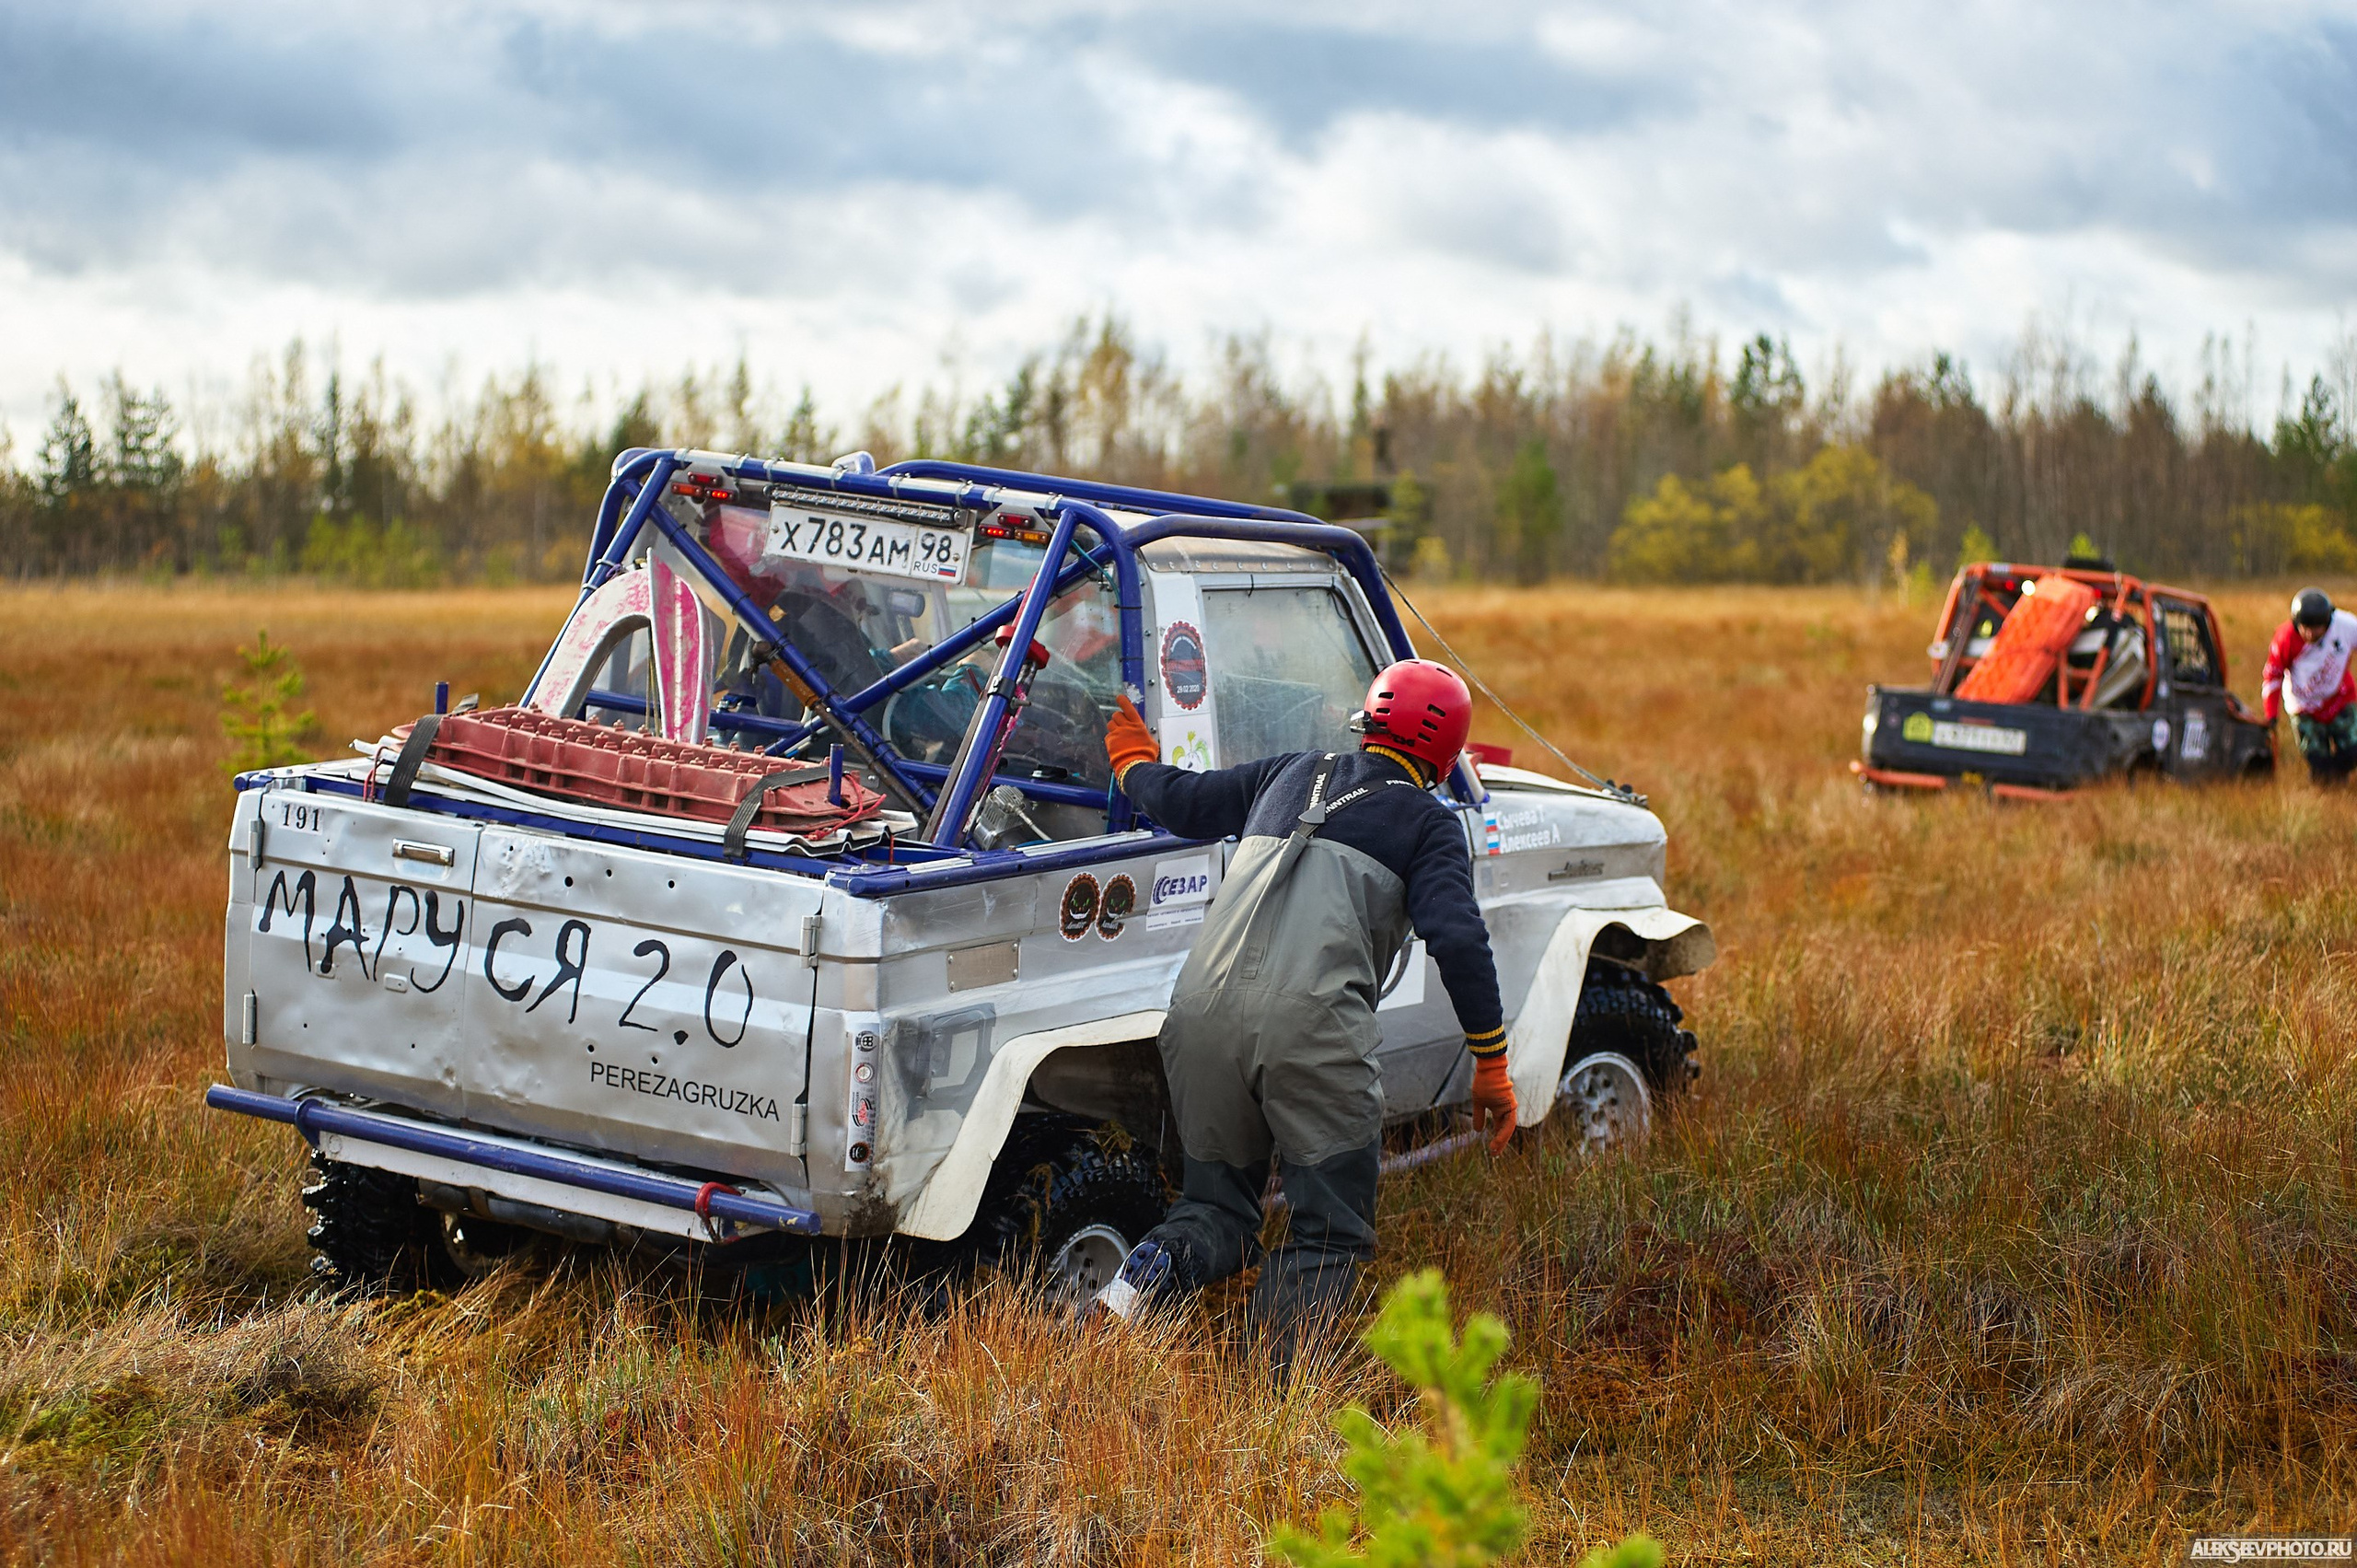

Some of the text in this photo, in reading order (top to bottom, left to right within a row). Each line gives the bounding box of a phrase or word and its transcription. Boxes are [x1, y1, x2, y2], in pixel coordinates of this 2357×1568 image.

[921, 532, 952, 563] 98
[912, 561, 938, 575] RUS
[283, 803, 320, 831] 191
[258, 870, 755, 1048] МАРУСЯ 2.0
[590, 1061, 781, 1122] PEREZAGRUZKA
